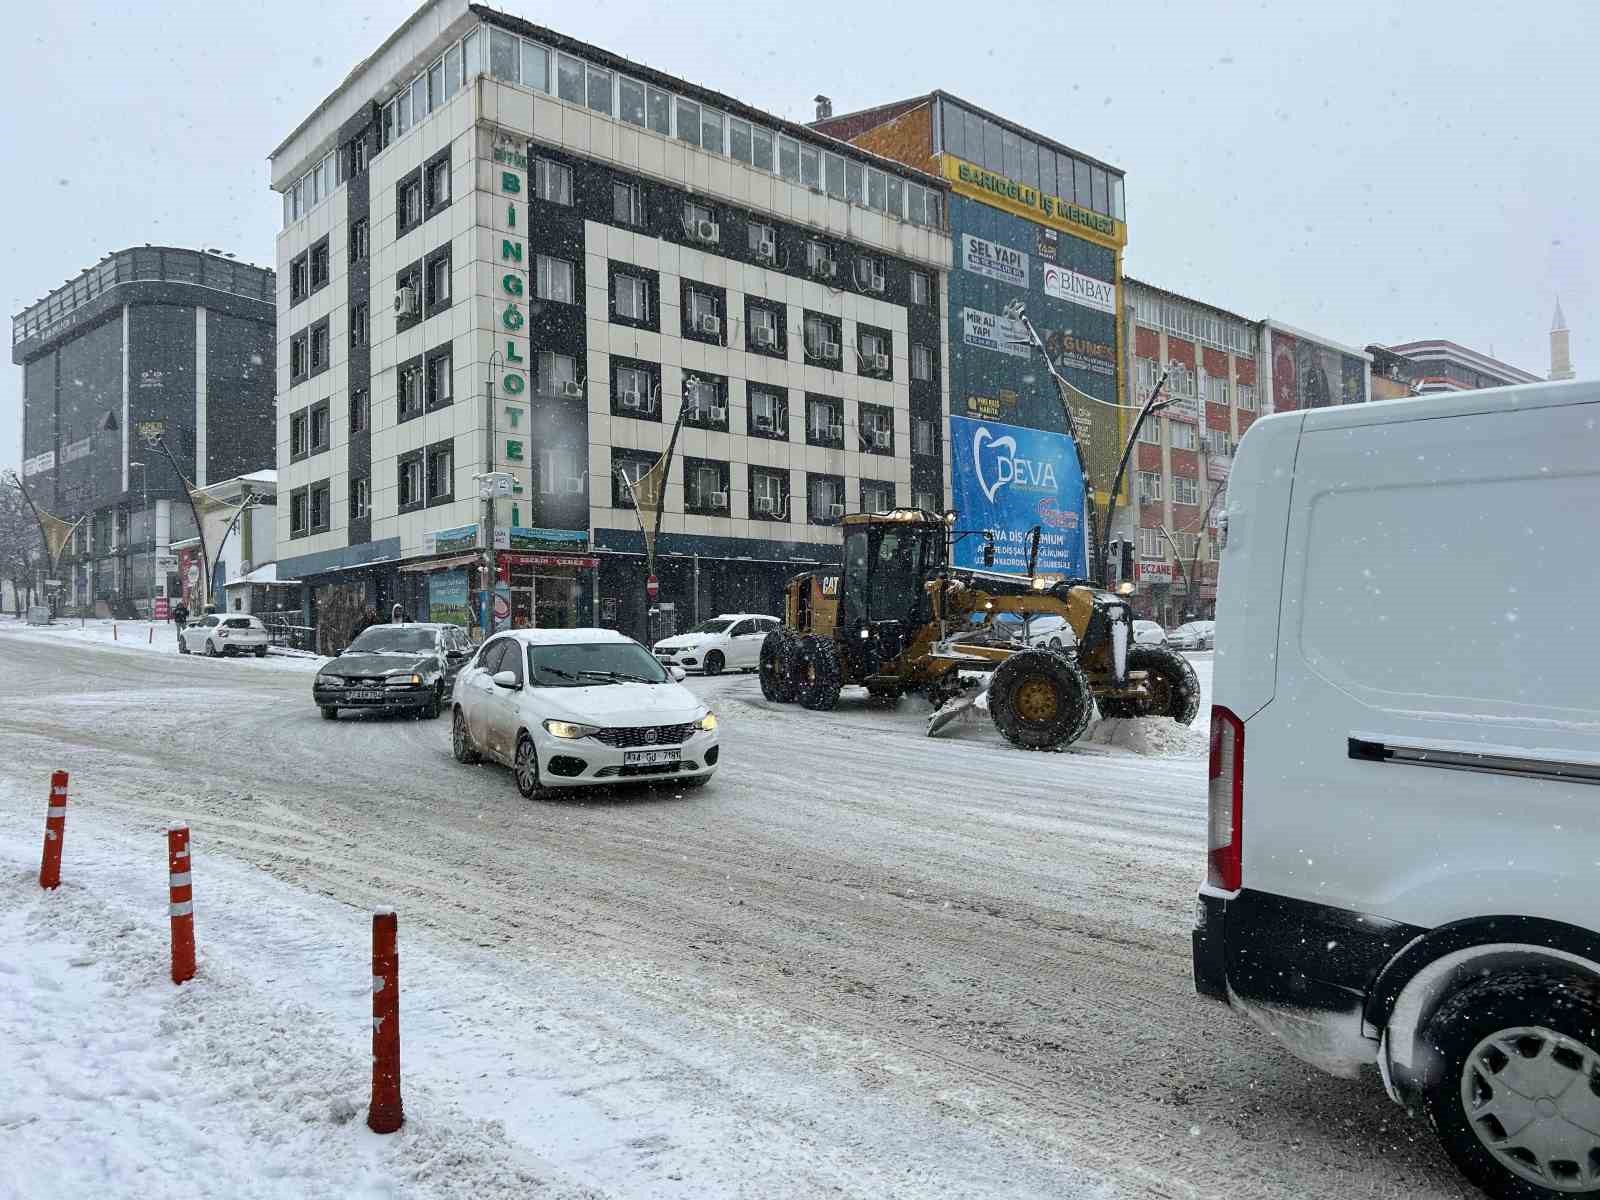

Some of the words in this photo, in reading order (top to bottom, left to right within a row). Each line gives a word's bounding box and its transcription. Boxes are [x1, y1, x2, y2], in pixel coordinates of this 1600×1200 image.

[970, 239, 992, 257] SEL
[993, 245, 1021, 267] YAPI
[1060, 271, 1111, 302] BİNBAY
[966, 311, 980, 325] MİR
[983, 315, 996, 328] ALİ
[973, 324, 990, 337] YAPI
[997, 456, 1057, 489] DEVA
[822, 576, 840, 595] CAT
